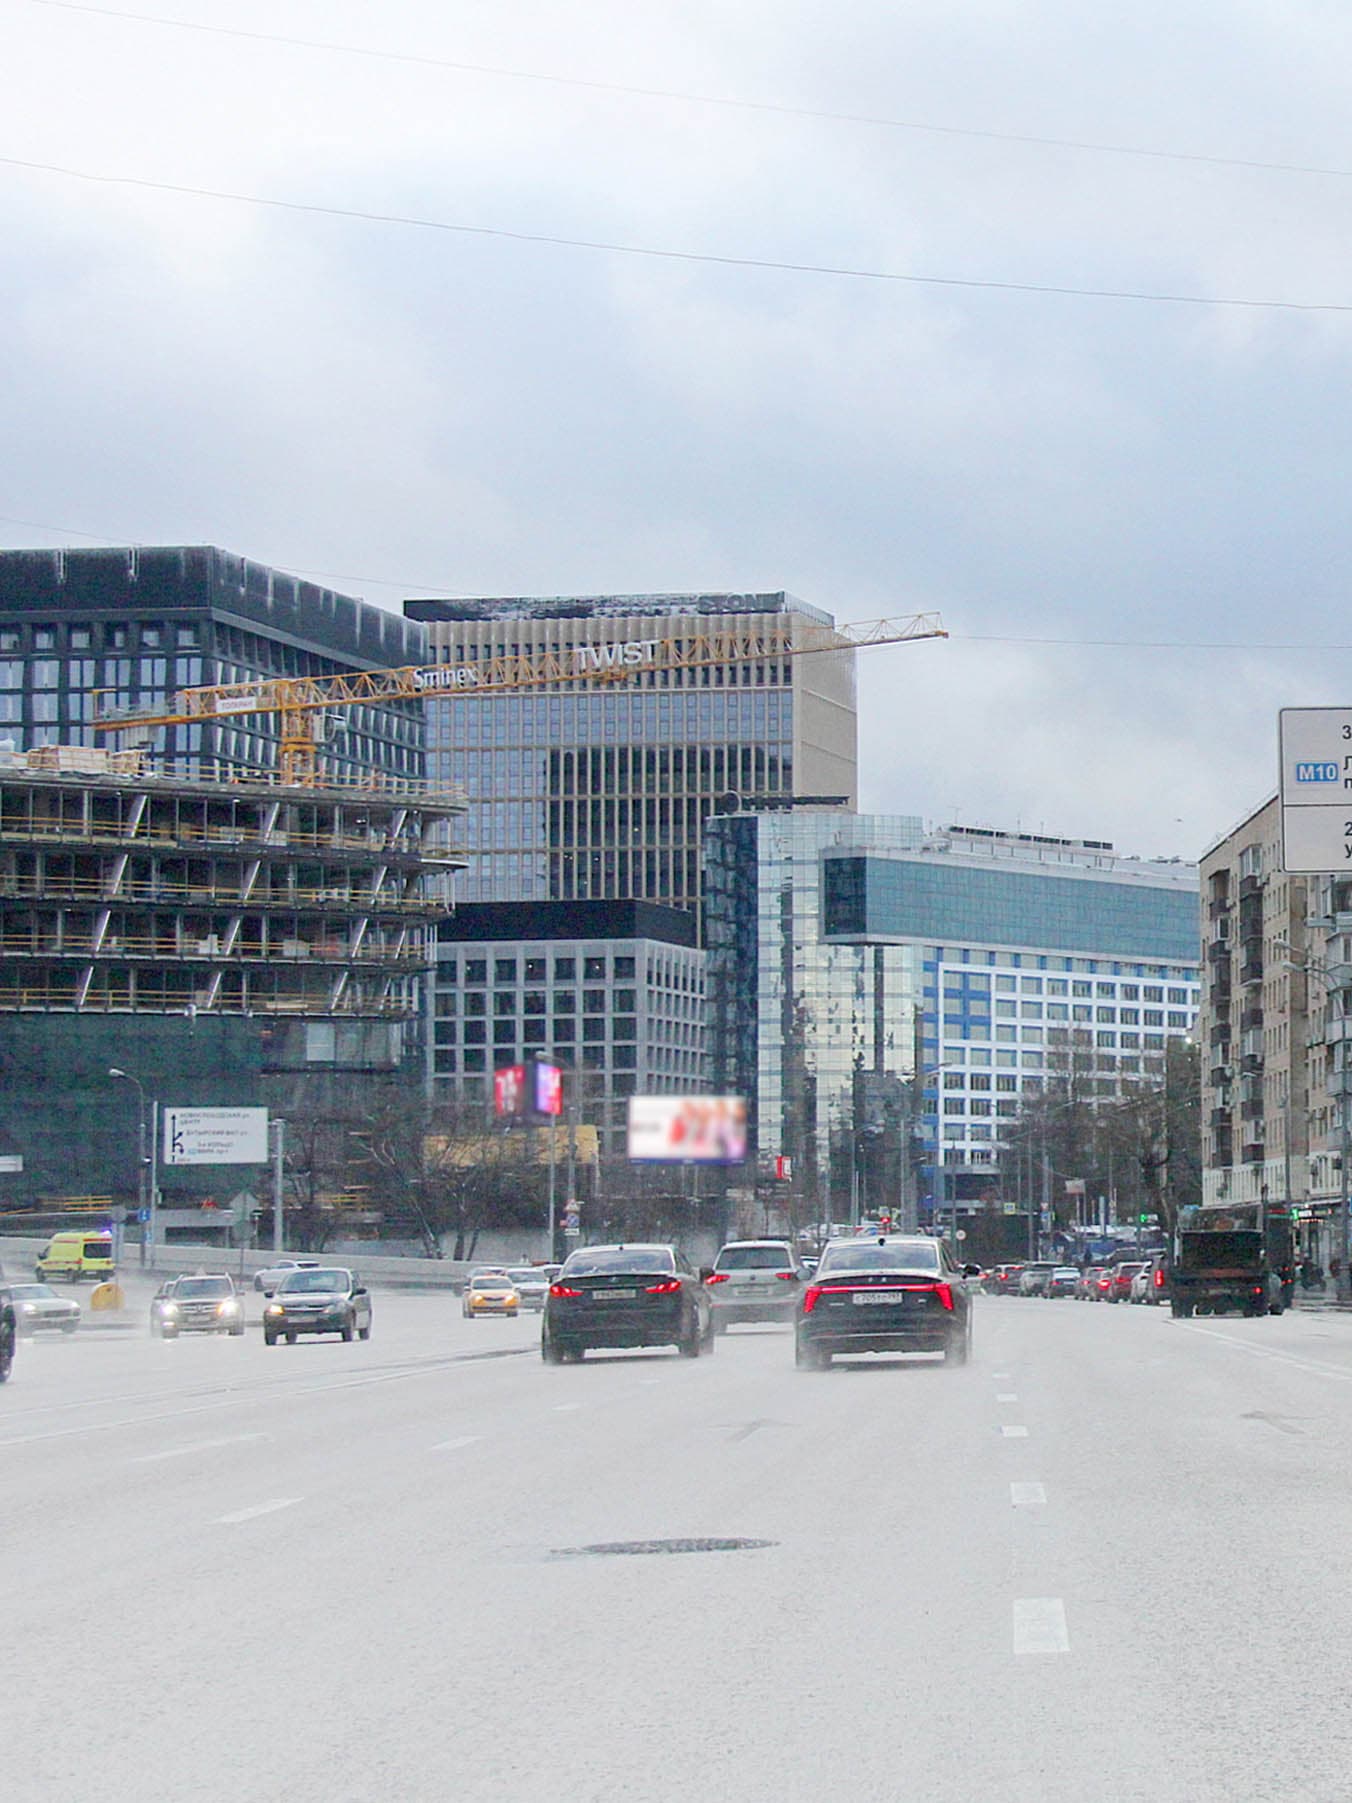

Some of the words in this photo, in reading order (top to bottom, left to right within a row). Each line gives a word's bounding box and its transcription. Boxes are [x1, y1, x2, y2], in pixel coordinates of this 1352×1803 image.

[574, 640, 660, 670] TWIST
[413, 667, 477, 689] Sminex
[1298, 763, 1337, 781] М10
